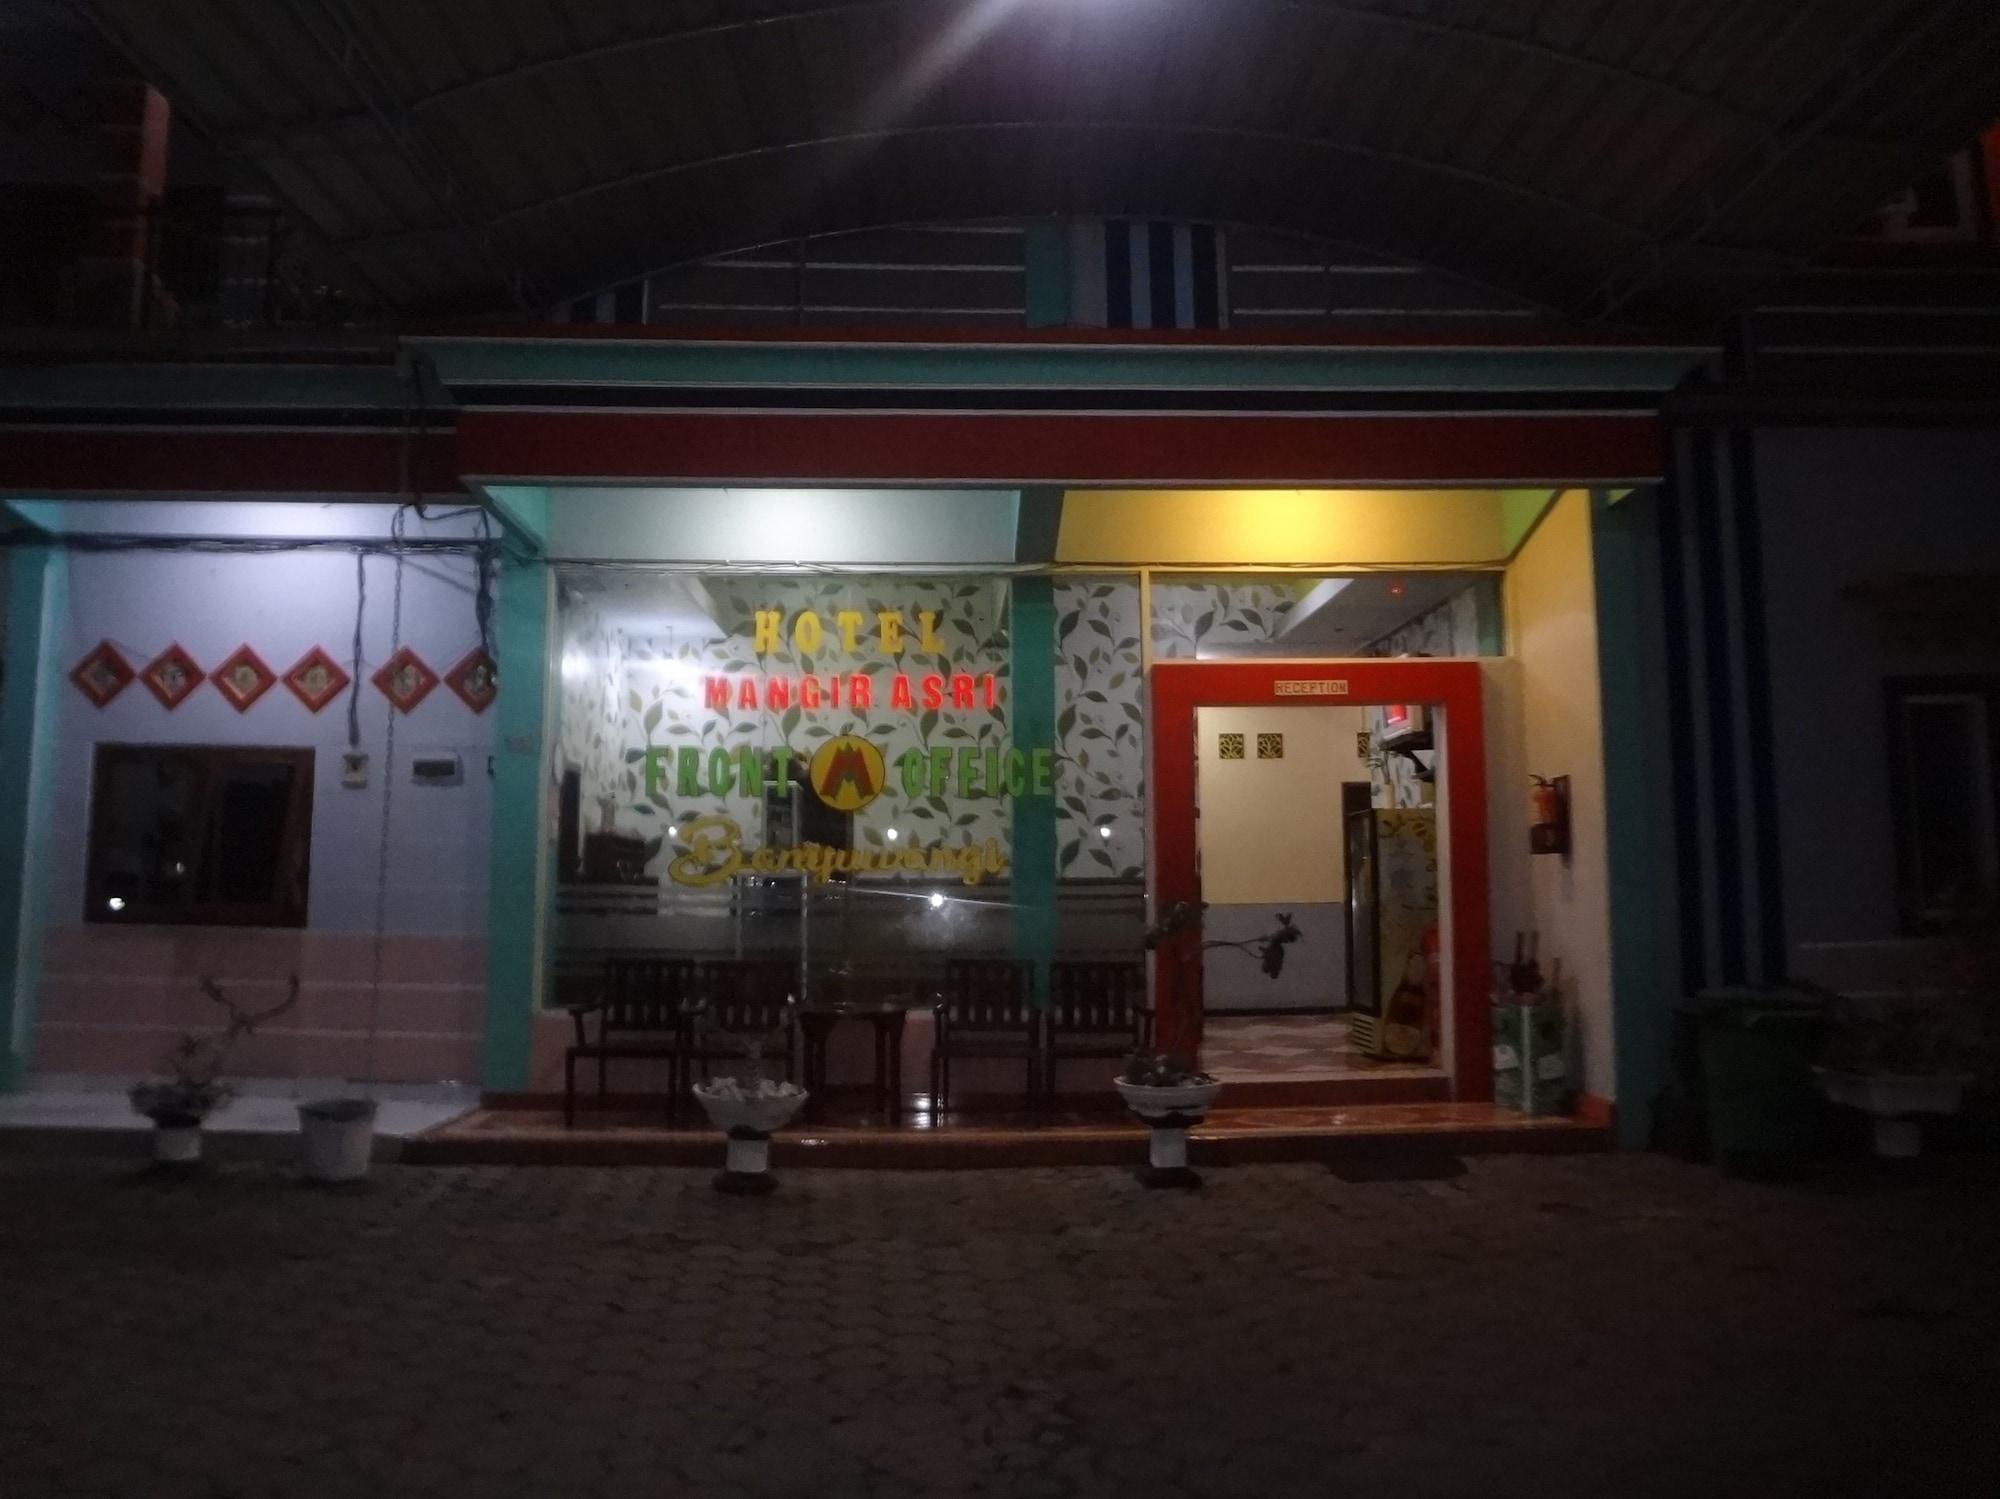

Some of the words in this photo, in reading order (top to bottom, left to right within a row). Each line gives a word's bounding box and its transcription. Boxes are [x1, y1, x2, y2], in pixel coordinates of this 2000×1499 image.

[752, 609, 945, 654] HOTEL
[704, 674, 872, 710] MANGIR
[891, 674, 997, 711] ASRI
[1275, 682, 1347, 694] RECEPTION
[644, 744, 796, 798] FRONT
[901, 746, 1056, 798] OFFICE
[667, 814, 1009, 887] Banyuwangi
